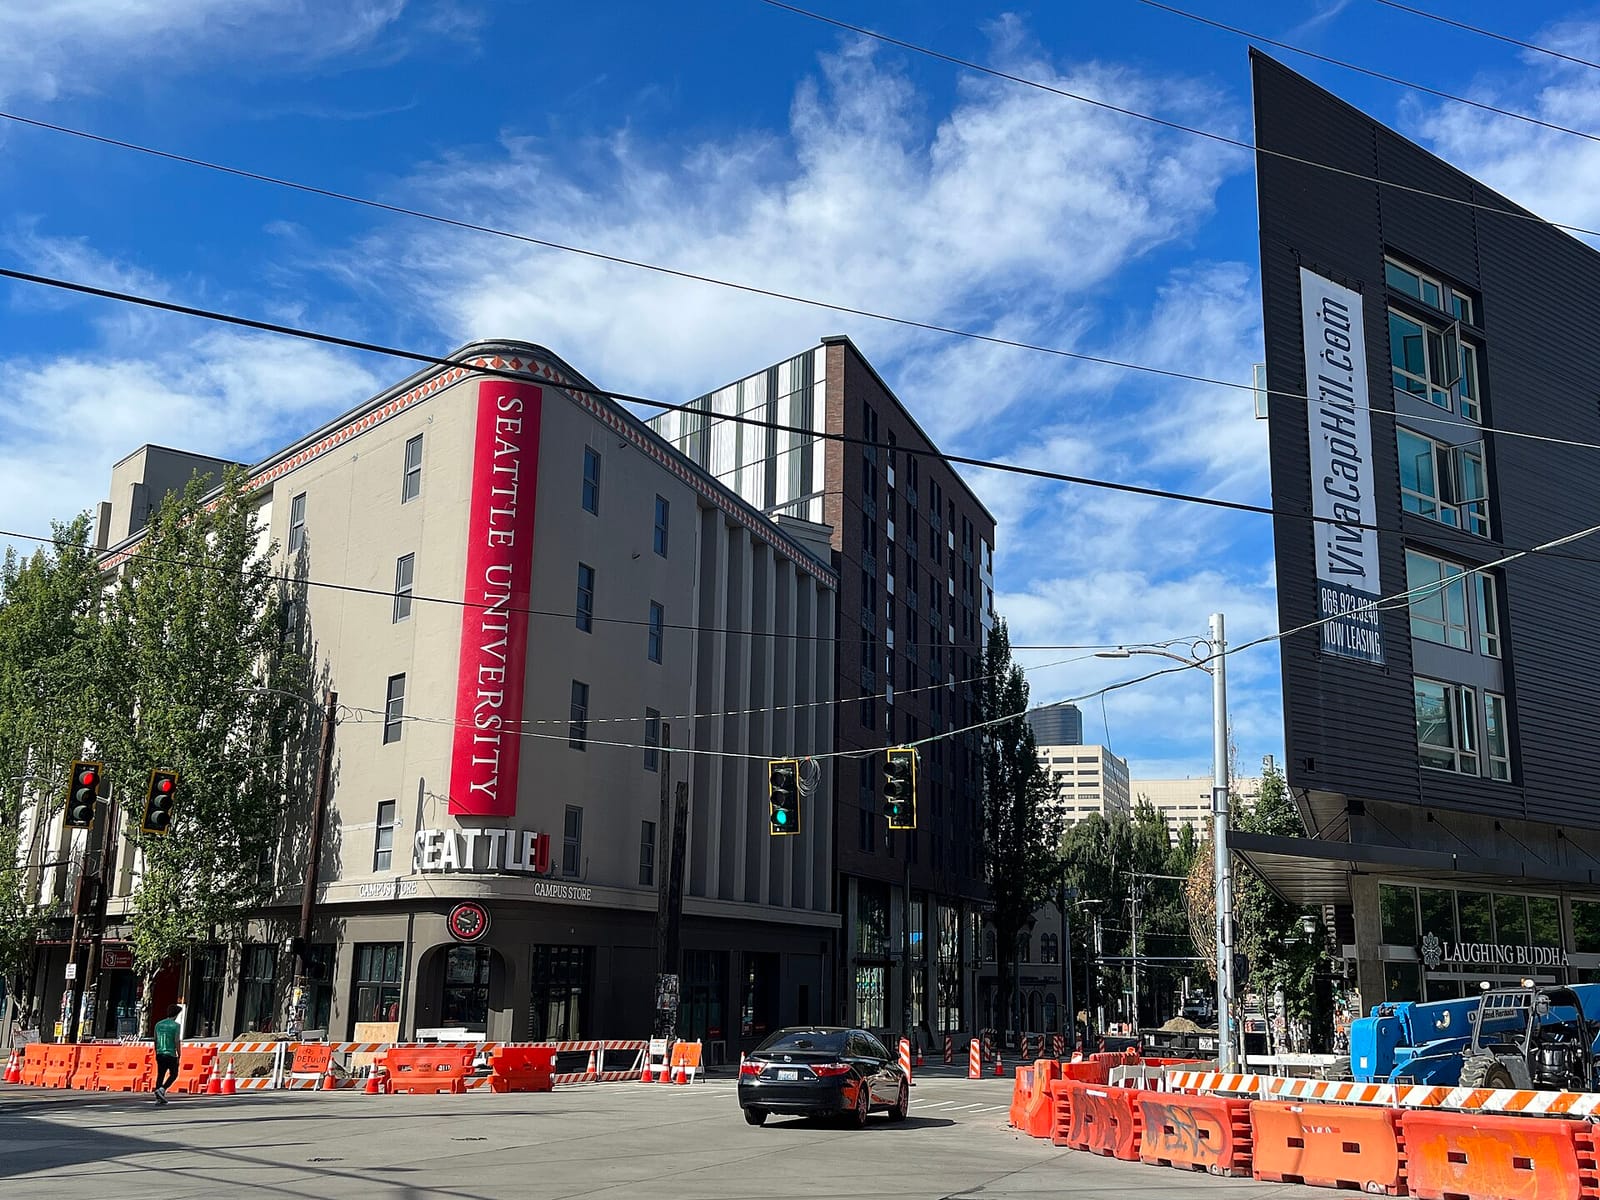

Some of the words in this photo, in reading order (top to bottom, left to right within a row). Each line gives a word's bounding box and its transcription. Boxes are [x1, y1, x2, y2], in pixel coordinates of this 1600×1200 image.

[1319, 296, 1366, 578] VivaCapHill.com
[487, 395, 523, 548] SEATTLE
[1323, 621, 1344, 647] NOW
[1346, 624, 1381, 655] LEASING
[470, 563, 513, 800] UNIVERSITY
[360, 882, 391, 897] CAMPUS
[391, 881, 417, 896] STORE
[534, 882, 567, 898] CAMPUS
[568, 886, 591, 900] STORE
[1443, 941, 1514, 965] LAUGHING
[1516, 945, 1569, 967] BUDDHA
[296, 1055, 327, 1063] DETOUR
